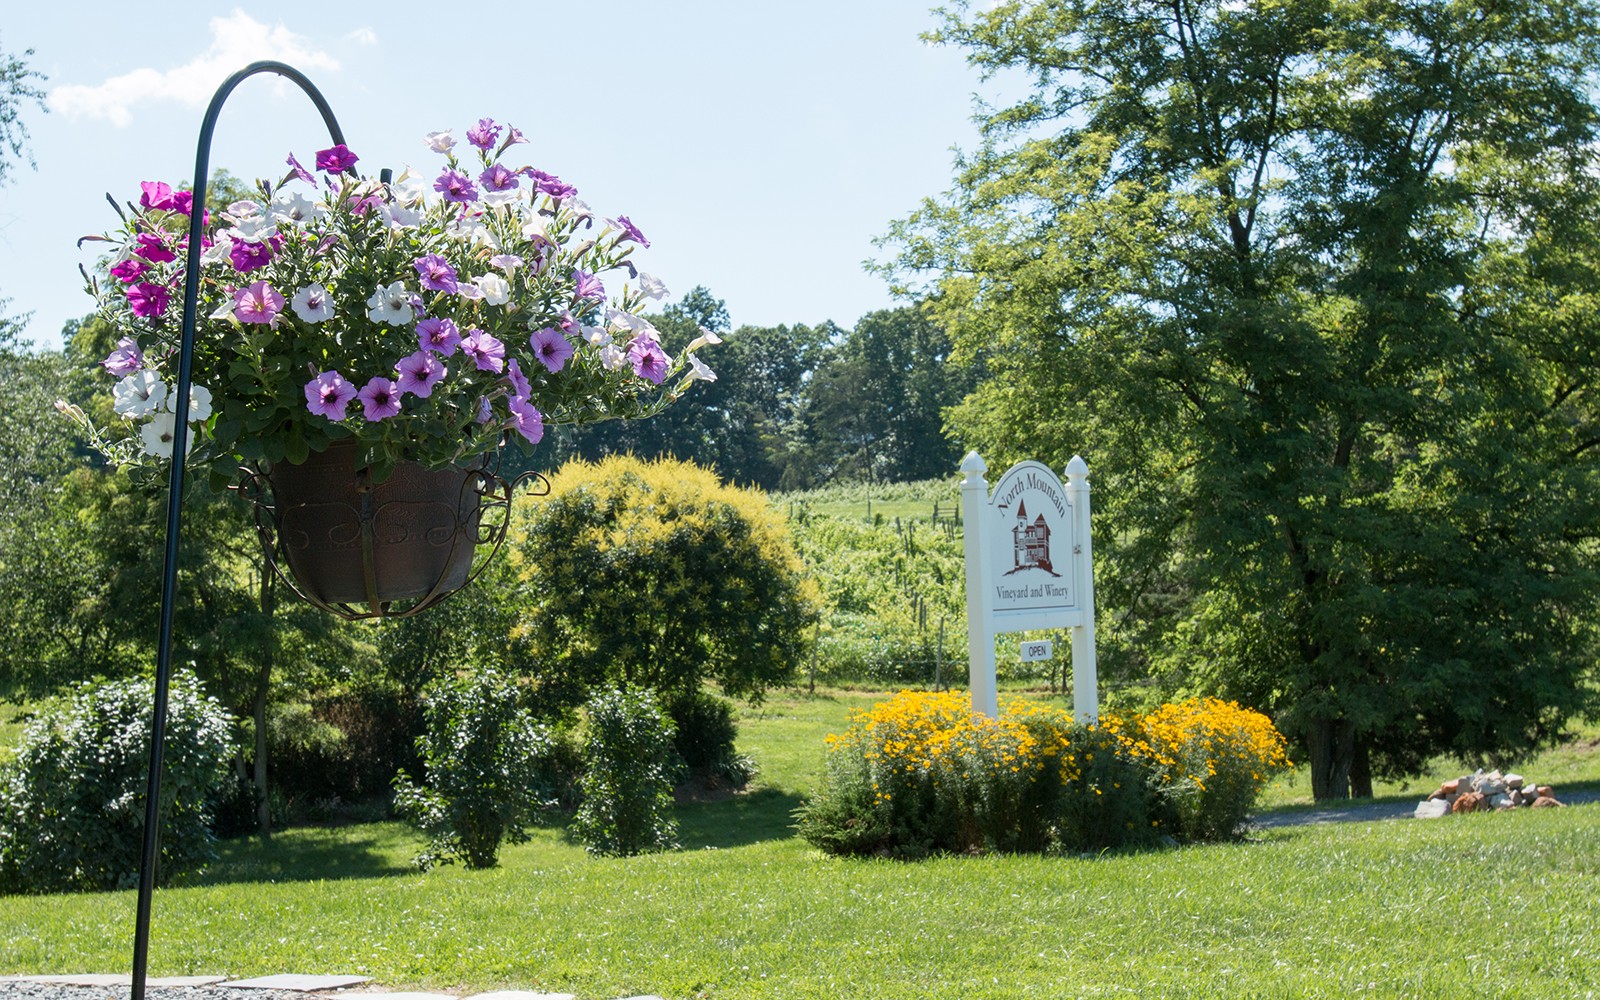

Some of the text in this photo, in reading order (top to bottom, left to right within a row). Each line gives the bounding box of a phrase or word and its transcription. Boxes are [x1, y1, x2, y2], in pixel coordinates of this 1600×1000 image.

[998, 473, 1065, 518] North Mountain
[996, 584, 1068, 602] Vineyard and Winery
[1028, 645, 1046, 657] OPEN
